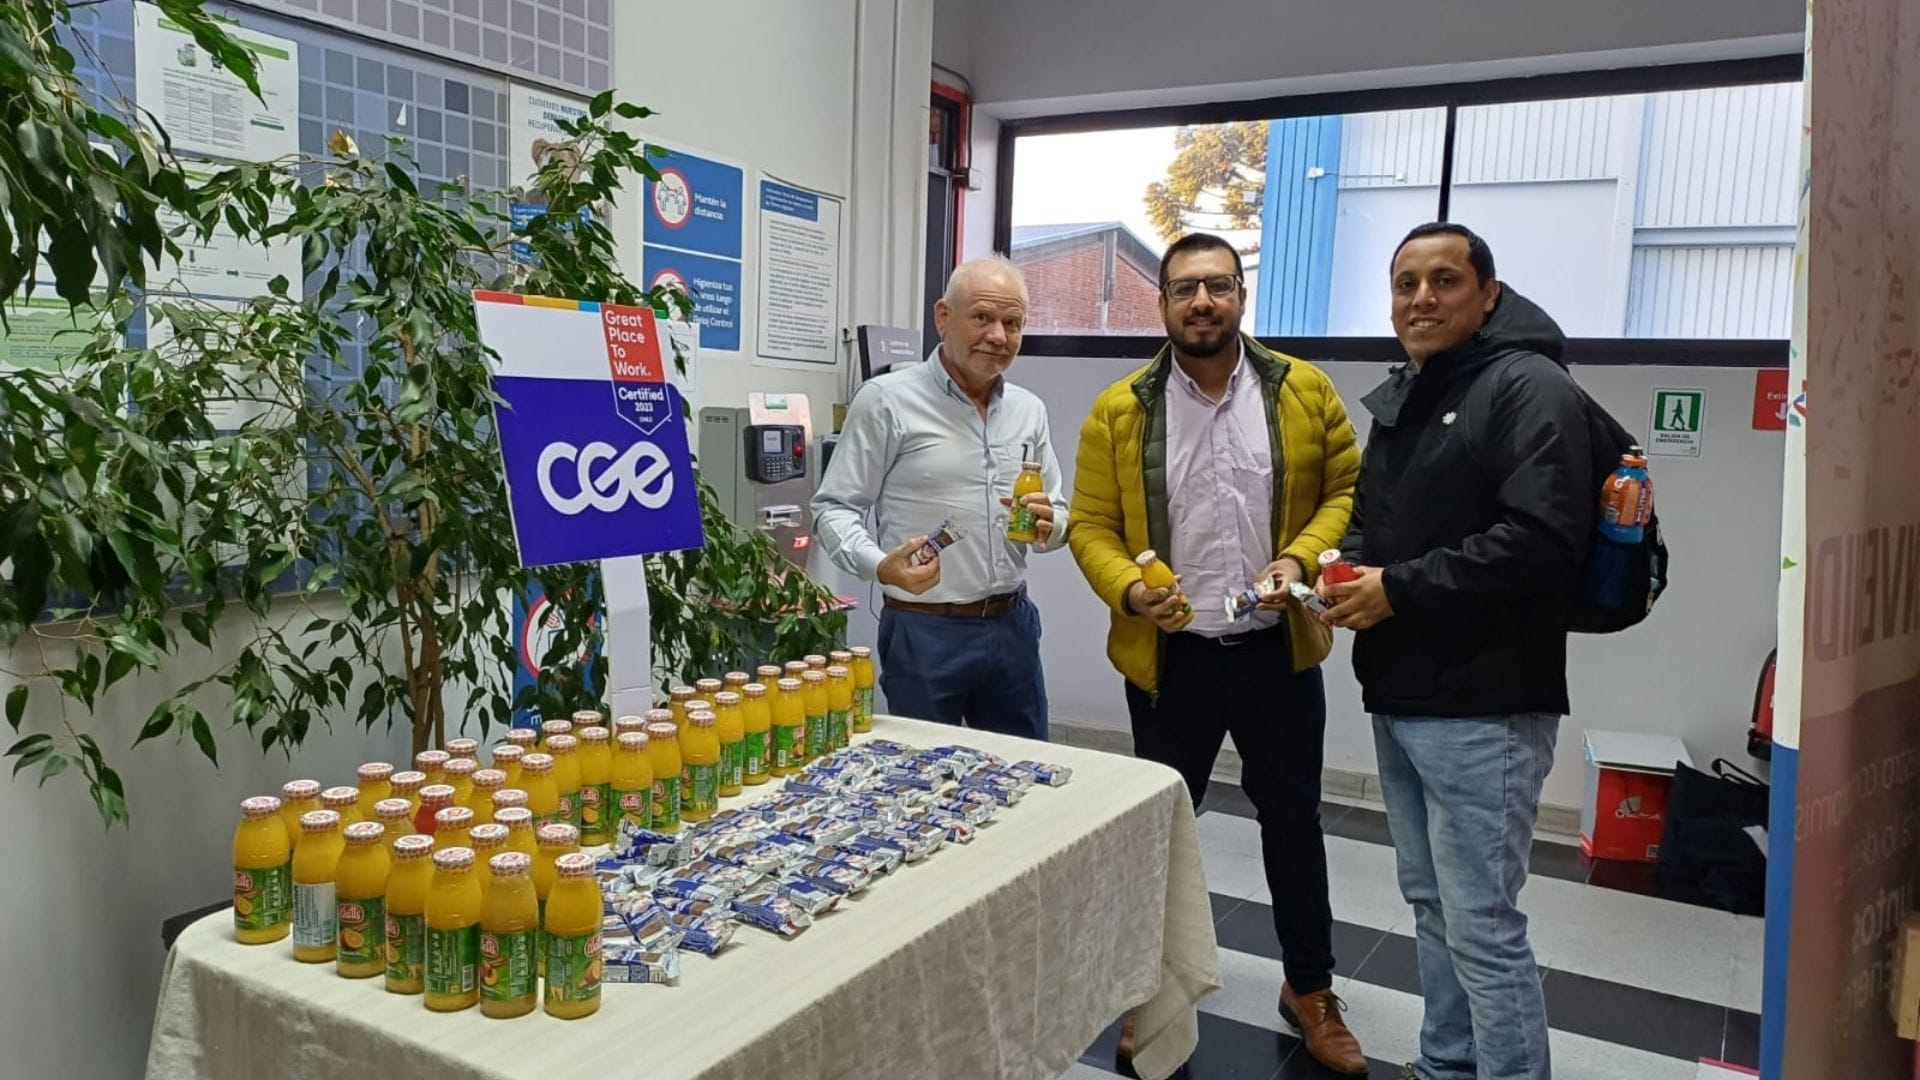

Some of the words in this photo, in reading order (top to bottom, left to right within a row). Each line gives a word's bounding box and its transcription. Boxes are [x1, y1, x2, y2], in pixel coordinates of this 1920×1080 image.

[694, 206, 724, 220] distancia
[604, 310, 643, 328] Great
[710, 317, 734, 329] Control
[608, 327, 646, 344] Place
[609, 343, 627, 358] To
[613, 361, 652, 377] Work.
[618, 386, 665, 401] Certified
